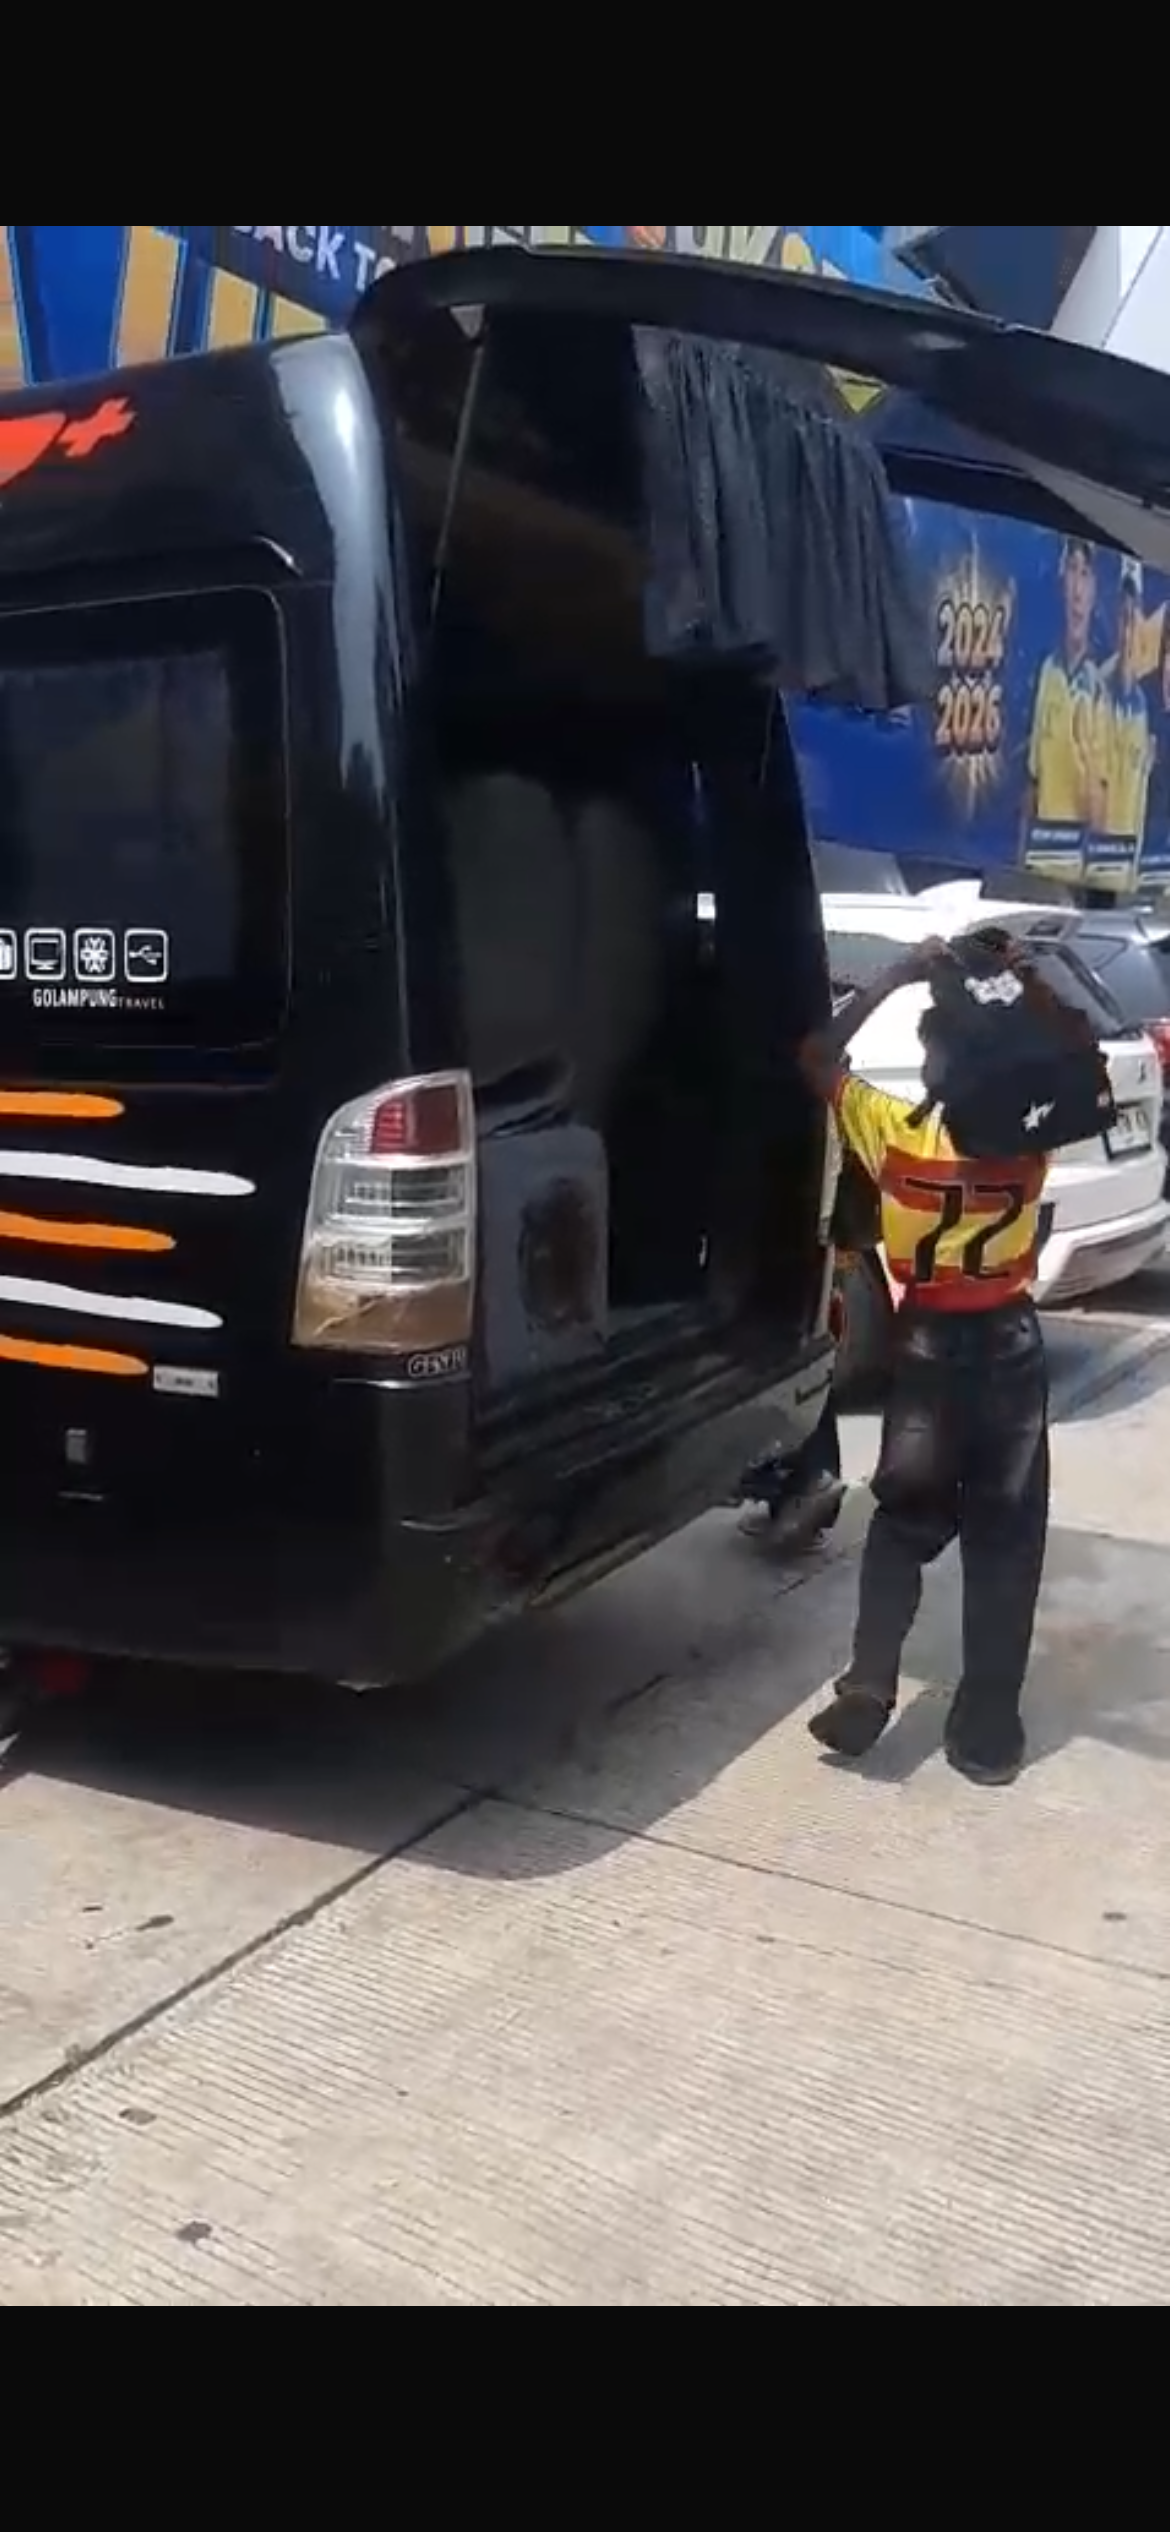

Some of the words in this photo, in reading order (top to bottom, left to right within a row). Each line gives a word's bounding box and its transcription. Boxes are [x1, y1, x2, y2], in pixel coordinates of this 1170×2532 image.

[233, 226, 345, 280] ACK
[937, 602, 1004, 667] 2024
[935, 685, 1002, 746] 2026
[33, 988, 117, 1008] GOLAMPUNG
[118, 996, 165, 1010] TRAVEL
[905, 1178, 1024, 1282] 72
